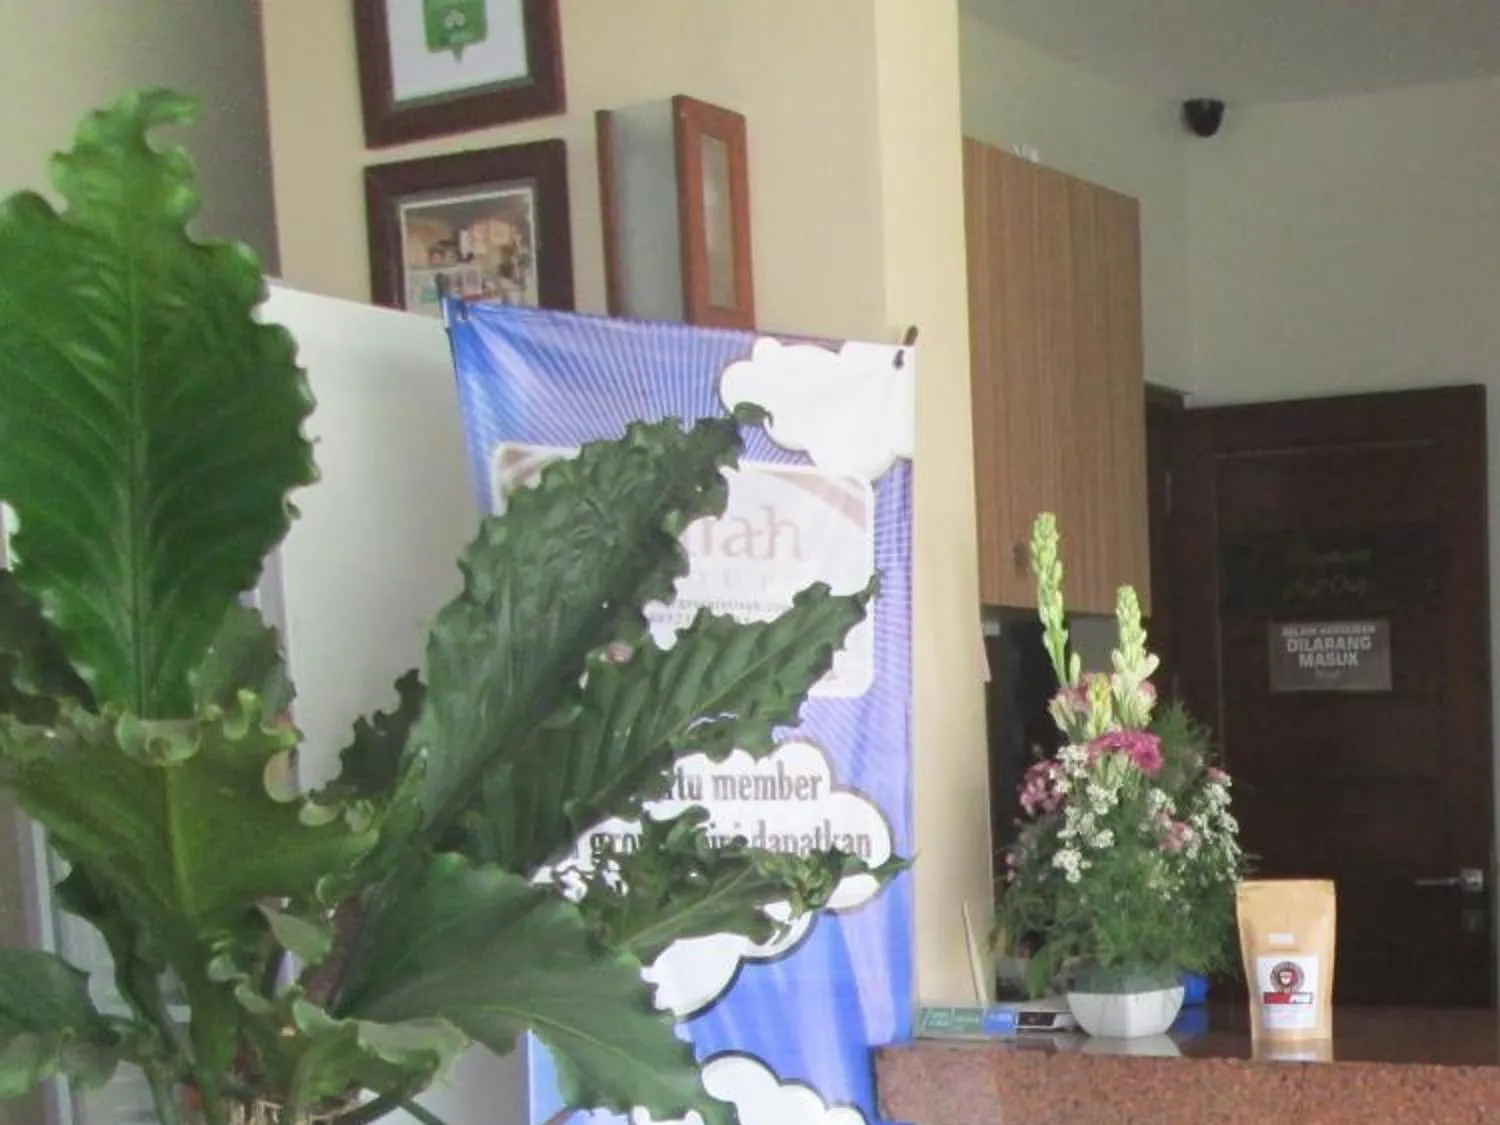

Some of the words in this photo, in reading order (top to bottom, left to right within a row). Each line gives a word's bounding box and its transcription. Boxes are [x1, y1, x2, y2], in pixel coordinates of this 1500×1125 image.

[1286, 635, 1373, 653] DILARANG
[1298, 652, 1360, 668] MASUK
[712, 760, 823, 801] member
